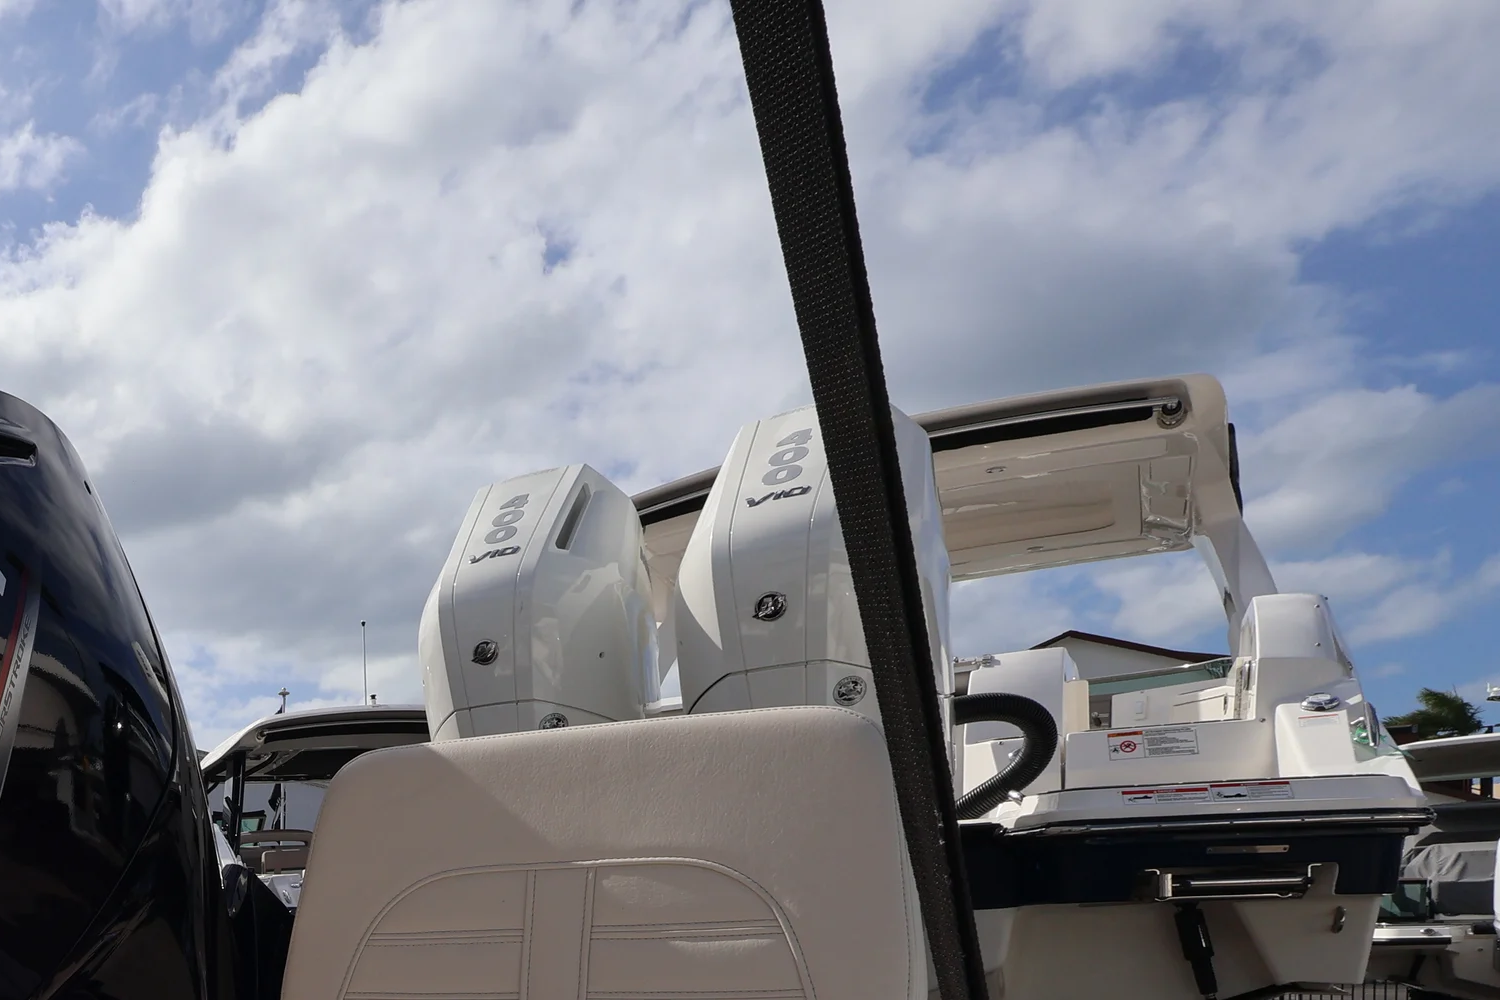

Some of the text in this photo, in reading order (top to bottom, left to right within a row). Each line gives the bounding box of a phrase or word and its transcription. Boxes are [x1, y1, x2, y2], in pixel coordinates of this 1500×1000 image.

[761, 428, 813, 486] 400
[745, 485, 813, 508] V10
[484, 493, 530, 545] 400
[468, 545, 522, 565] V10
